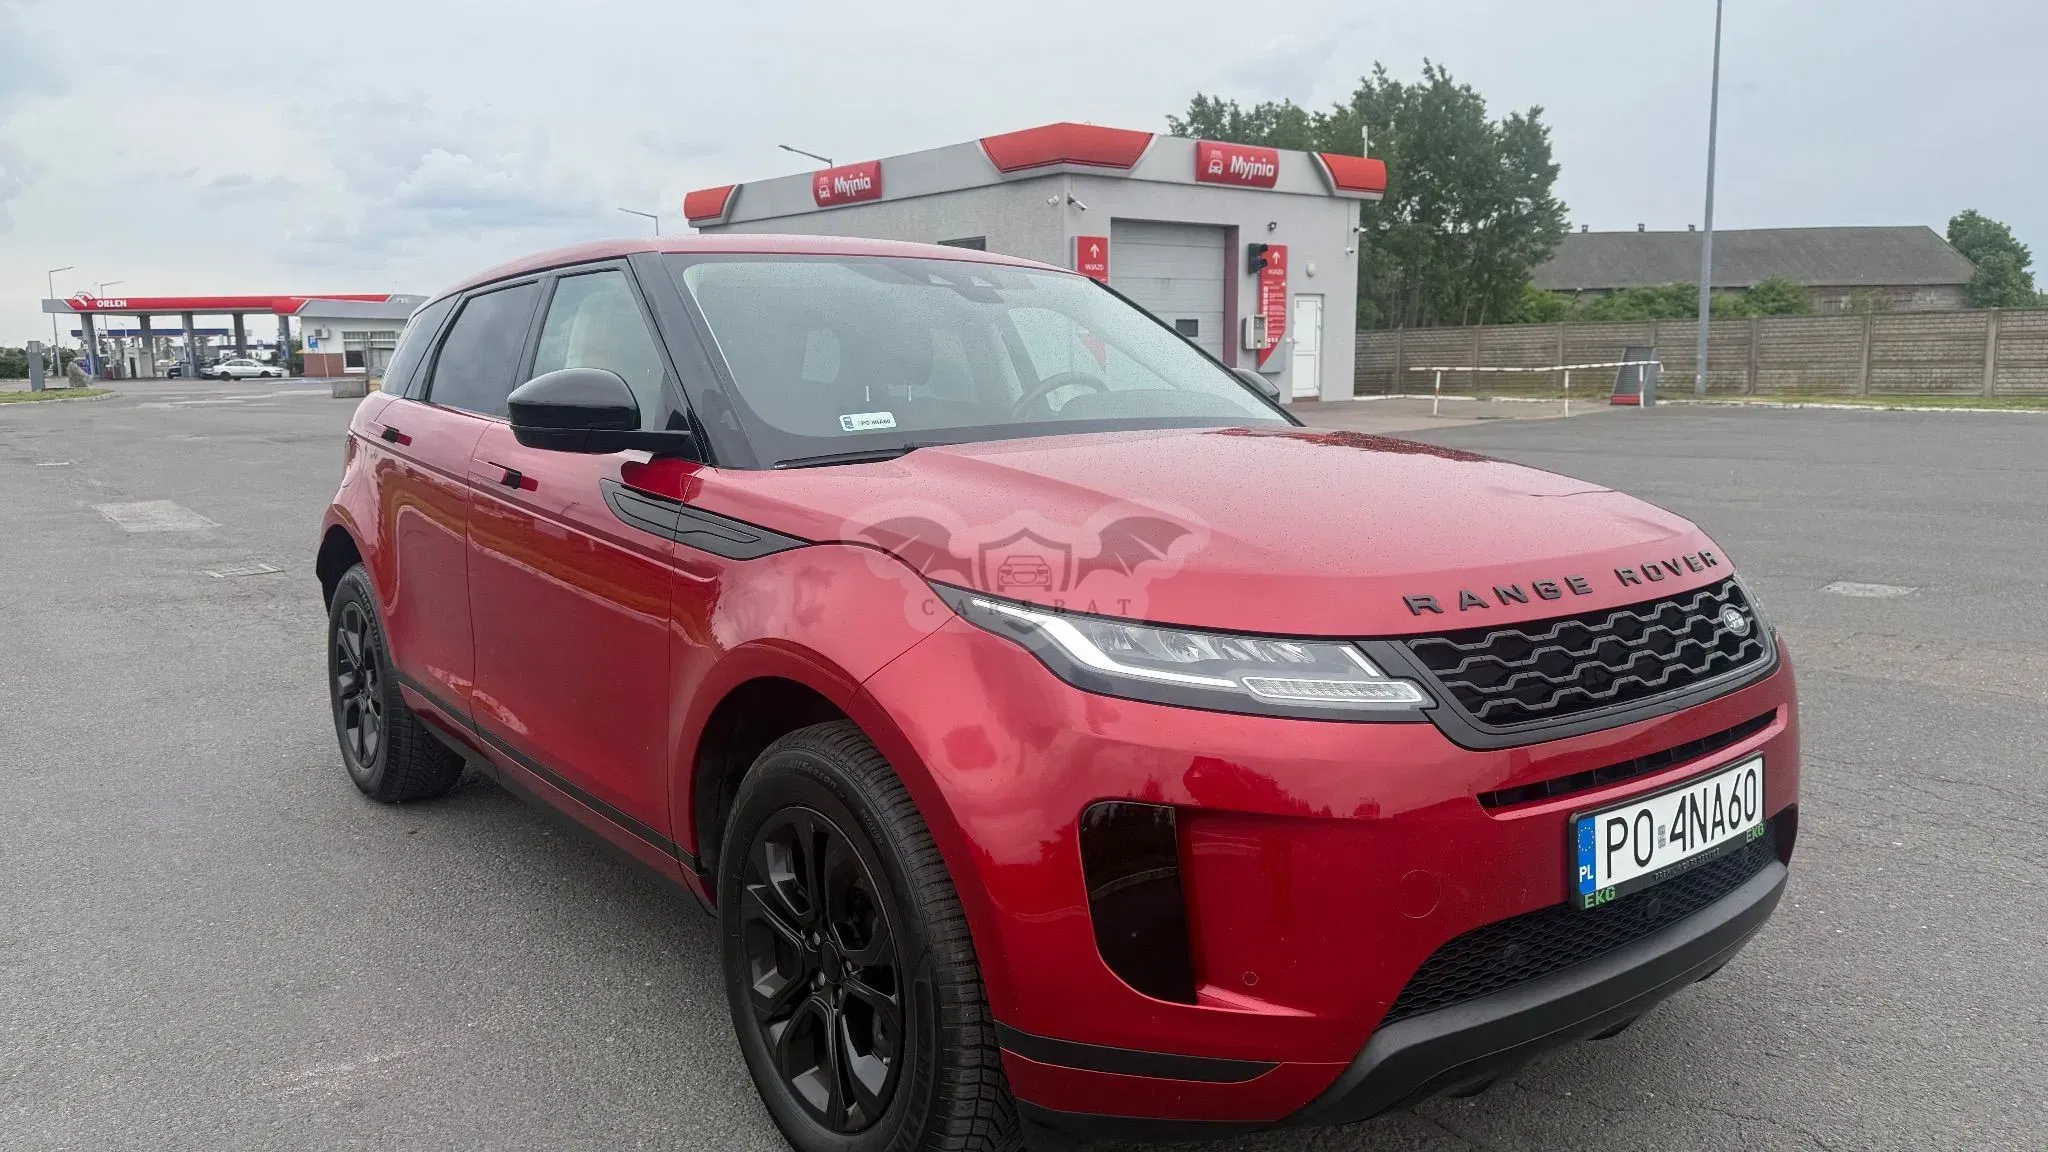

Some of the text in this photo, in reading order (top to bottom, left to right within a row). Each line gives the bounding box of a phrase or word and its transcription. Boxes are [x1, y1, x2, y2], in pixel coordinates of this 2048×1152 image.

[1230, 155, 1275, 180] Myjnia
[834, 172, 872, 197] Myjnia
[1085, 263, 1105, 271] WJAZD
[96, 299, 127, 308] ORLEN
[1402, 550, 1718, 616] RANGE ROVER
[1579, 768, 1757, 883] PL PO 4NA60
[1746, 822, 1765, 843] EKG
[1584, 885, 1616, 909] EKG
